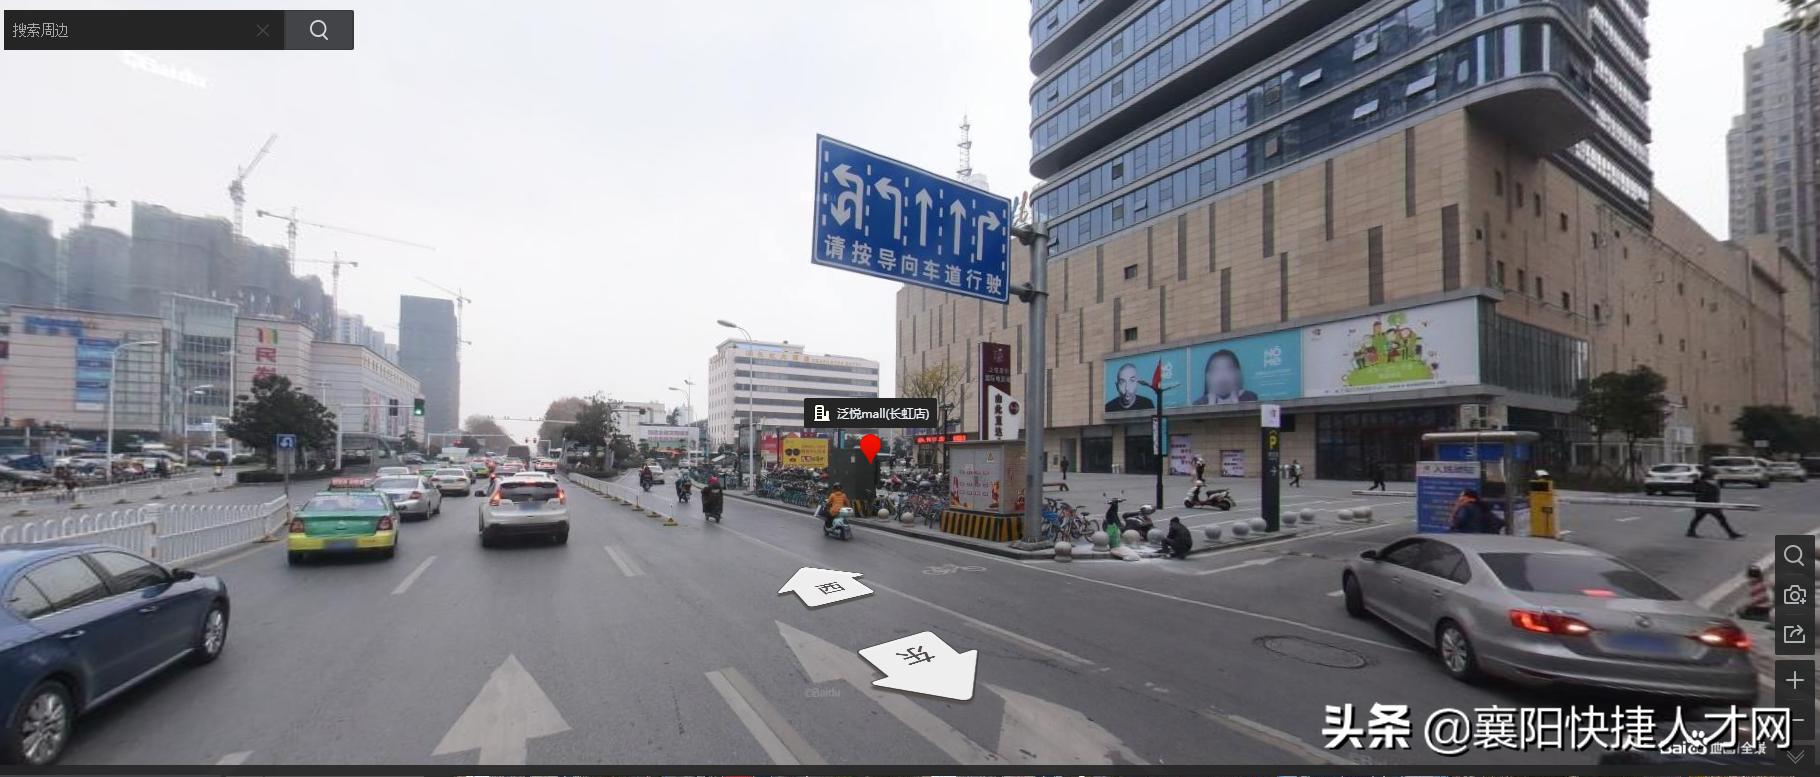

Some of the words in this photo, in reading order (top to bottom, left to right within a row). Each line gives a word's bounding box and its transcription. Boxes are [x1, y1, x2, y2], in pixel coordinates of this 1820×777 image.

[824, 233, 1002, 295] 请按导向车道行驶
